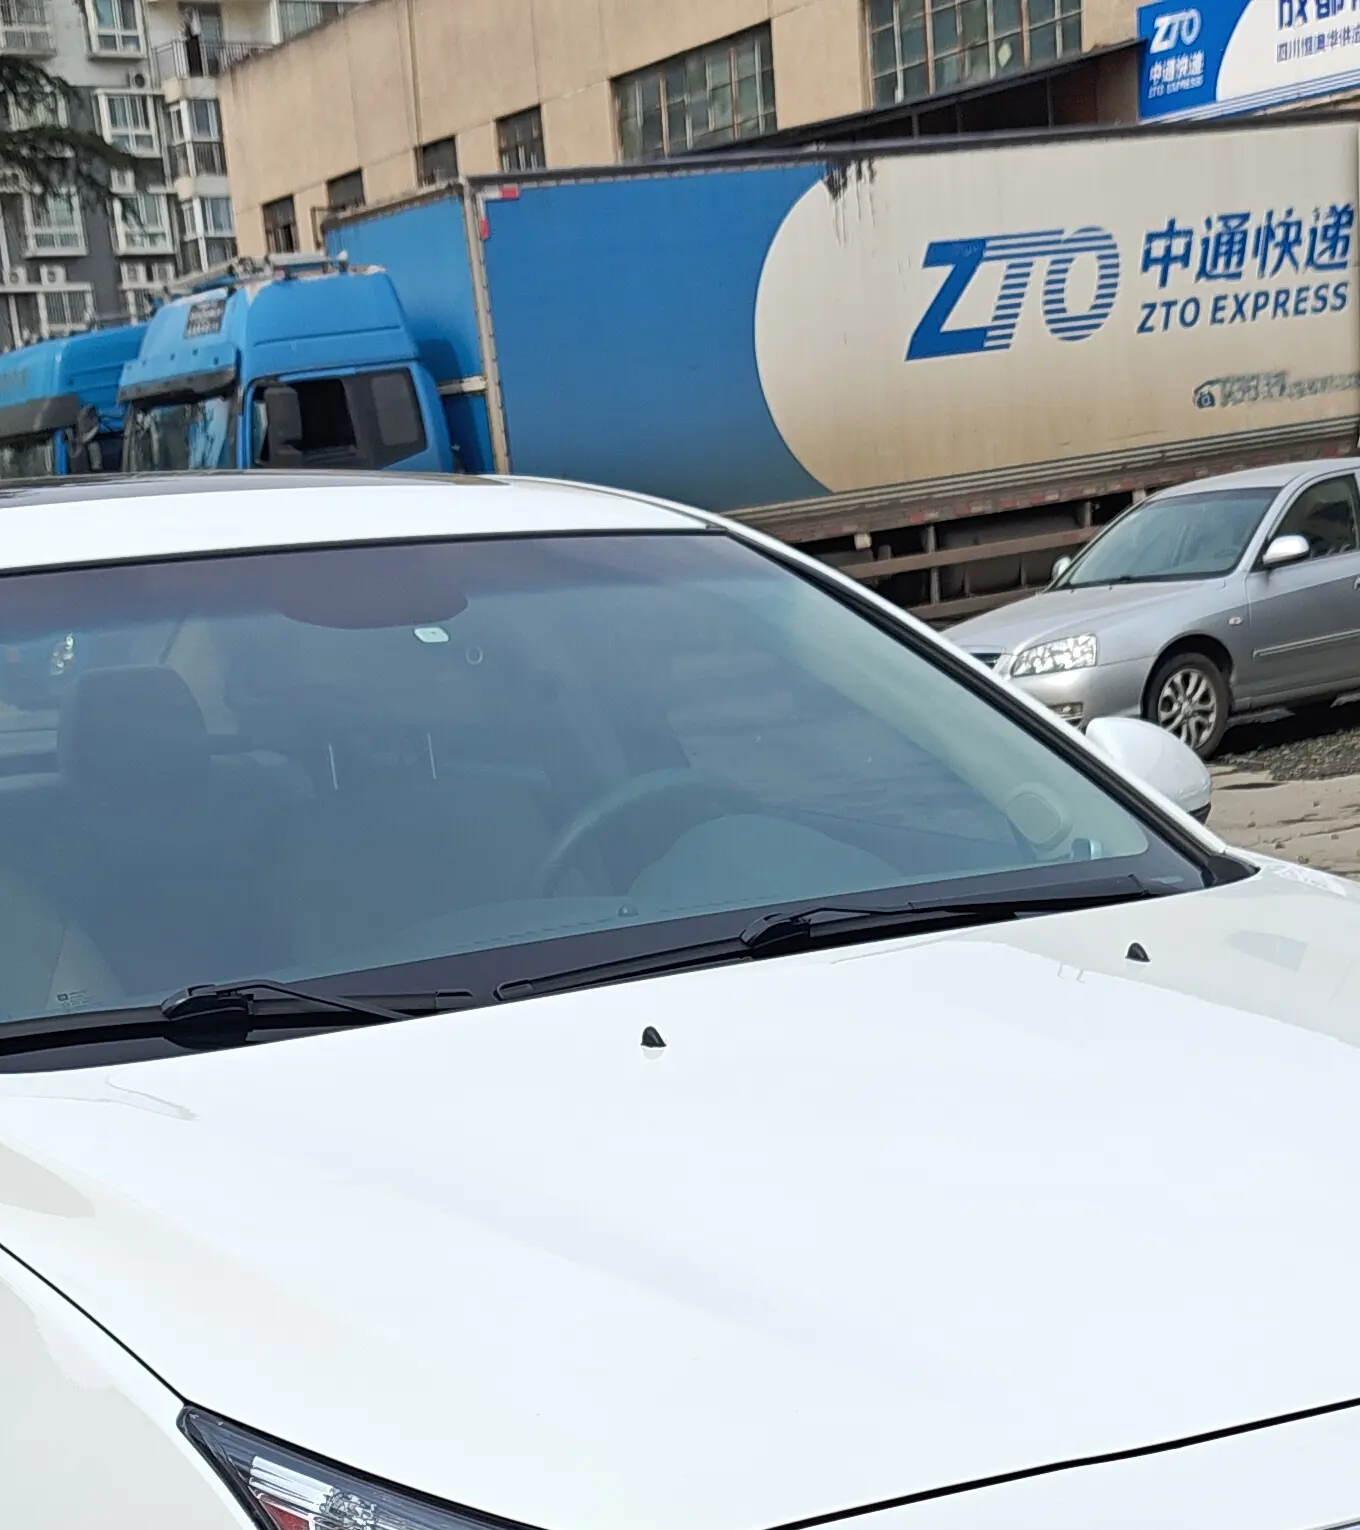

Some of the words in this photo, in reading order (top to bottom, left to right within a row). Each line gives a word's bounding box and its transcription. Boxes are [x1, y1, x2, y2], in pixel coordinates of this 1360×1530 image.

[1150, 8, 1201, 54] ZTO
[1141, 202, 1355, 288] 中通快递
[905, 226, 1120, 361] ZTO
[1136, 298, 1201, 335] ZTO
[1209, 281, 1349, 326] EXPRESS
